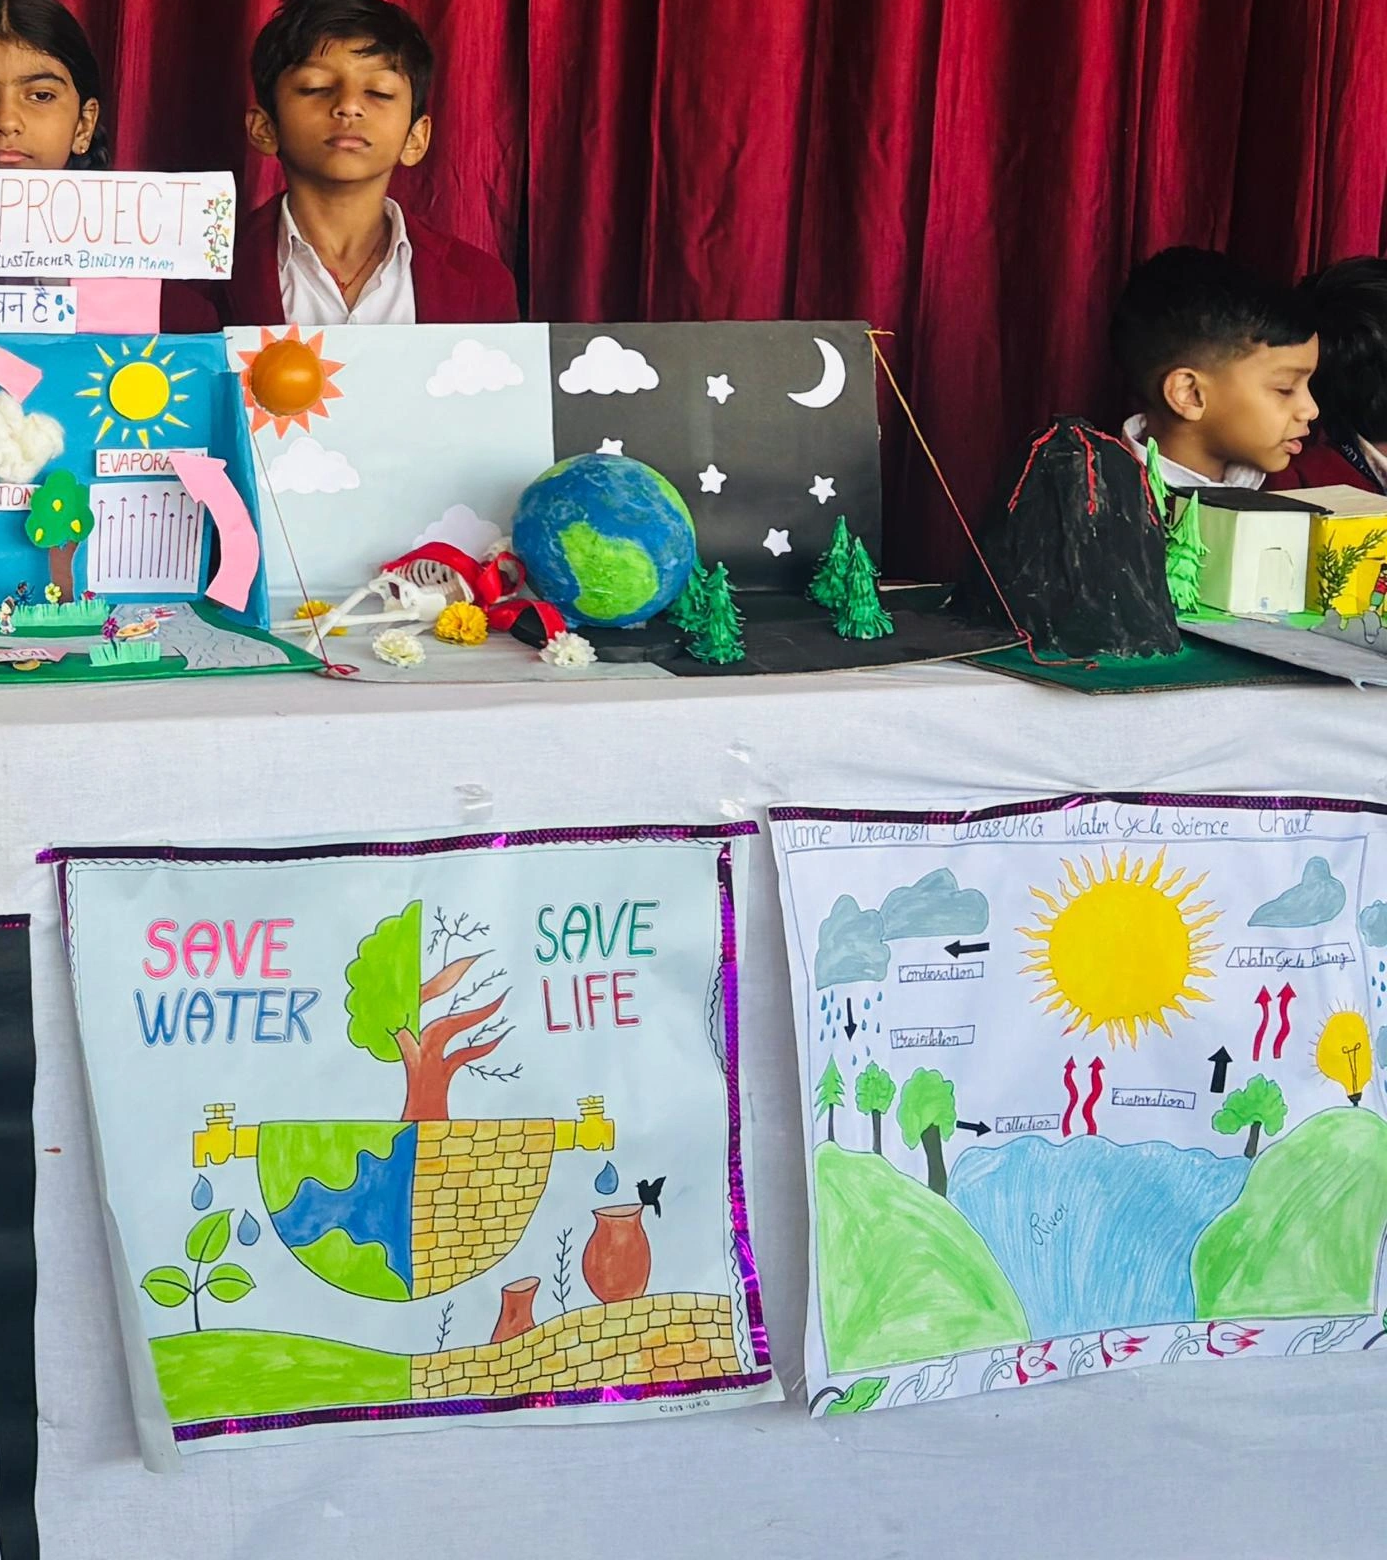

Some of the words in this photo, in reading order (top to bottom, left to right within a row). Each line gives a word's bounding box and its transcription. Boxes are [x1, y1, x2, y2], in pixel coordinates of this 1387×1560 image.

[77, 250, 134, 270] BINDIYA
[32, 278, 51, 324] है
[1258, 809, 1315, 835] Chart
[140, 915, 296, 981] SAVE
[533, 898, 662, 965] SAVE
[133, 987, 322, 1046] WATER
[541, 970, 640, 1034] LIFE
